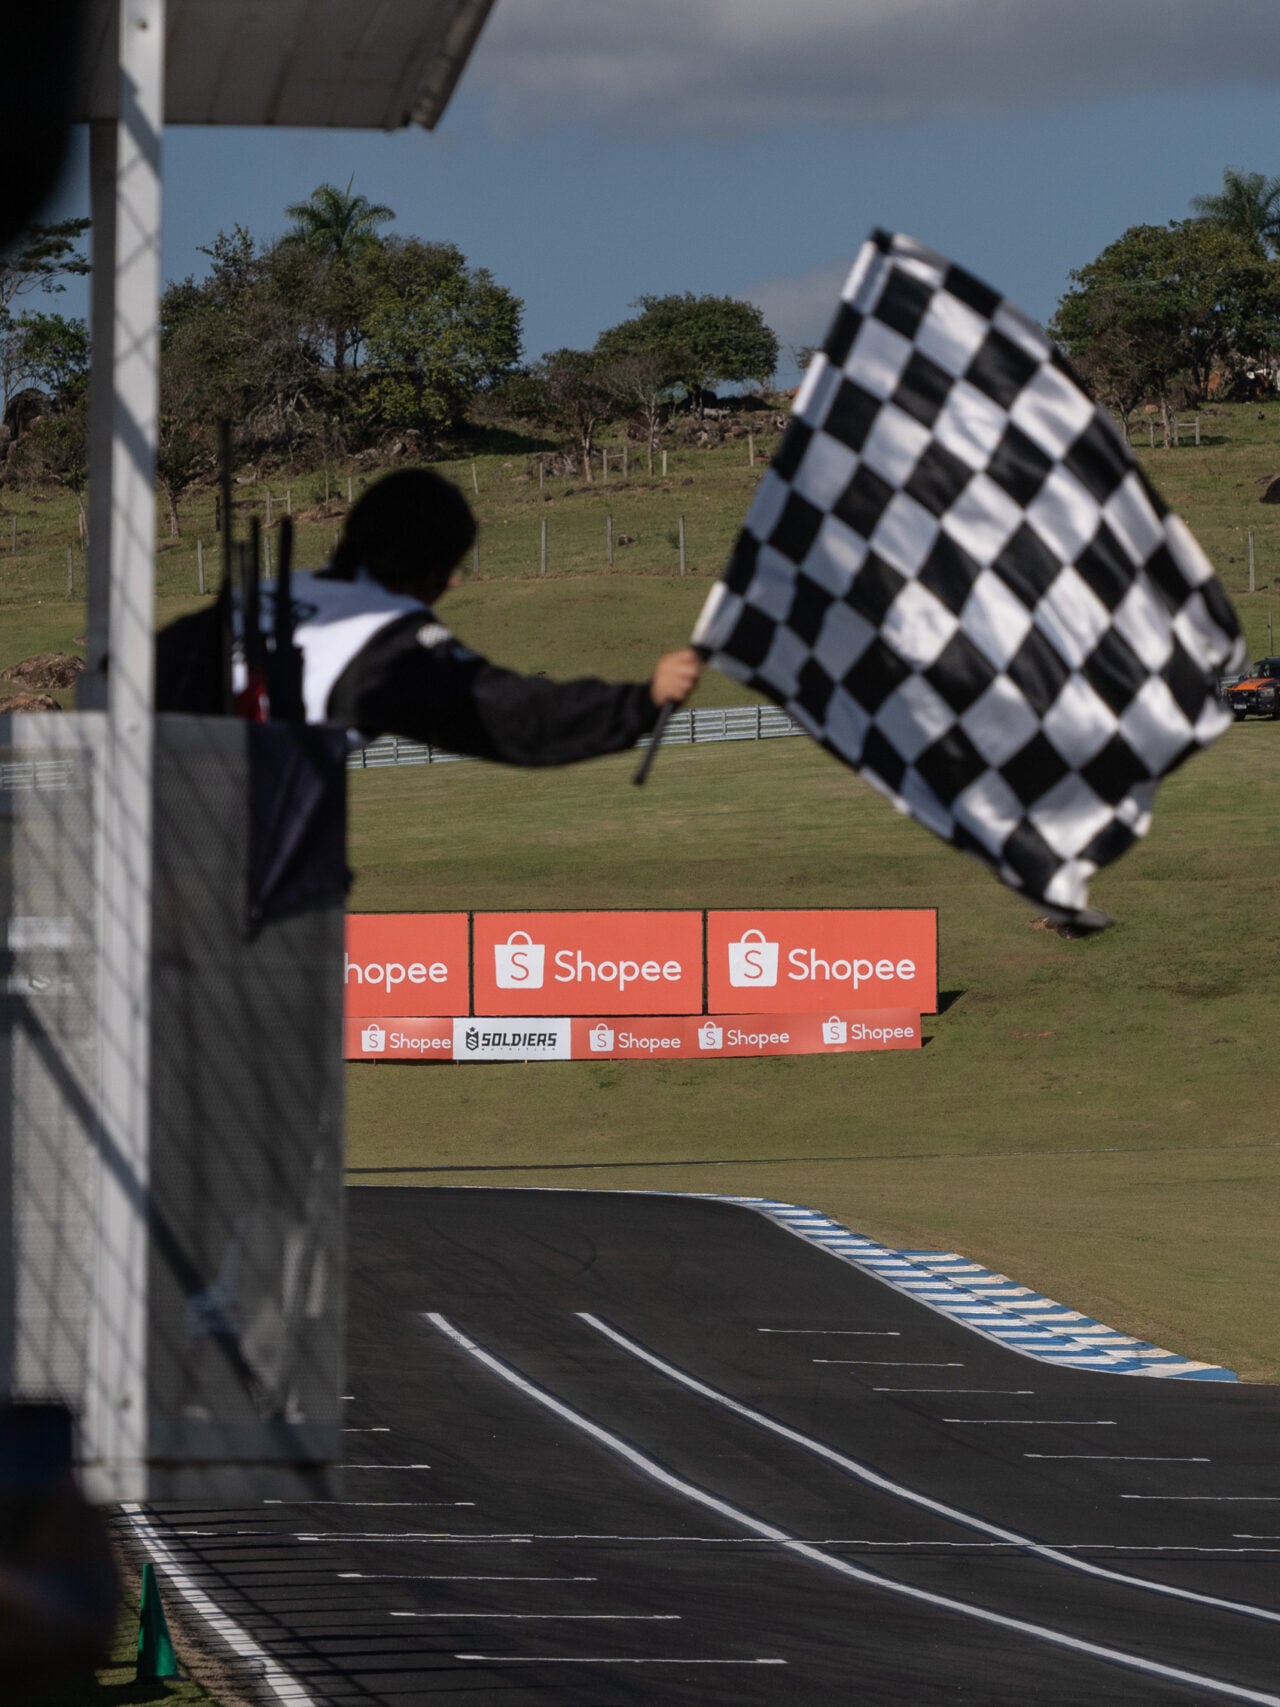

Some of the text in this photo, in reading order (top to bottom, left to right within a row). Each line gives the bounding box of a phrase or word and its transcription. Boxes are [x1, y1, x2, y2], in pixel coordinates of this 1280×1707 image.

[344, 952, 449, 993] hopee
[554, 950, 683, 992] Shopee
[788, 948, 916, 990] Shopee
[390, 1032, 451, 1053] Shopee
[481, 1032, 558, 1047] SOLDIERS
[618, 1031, 682, 1052] Shopee
[727, 1028, 790, 1049] Shopee
[851, 1022, 915, 1044] Shopee
